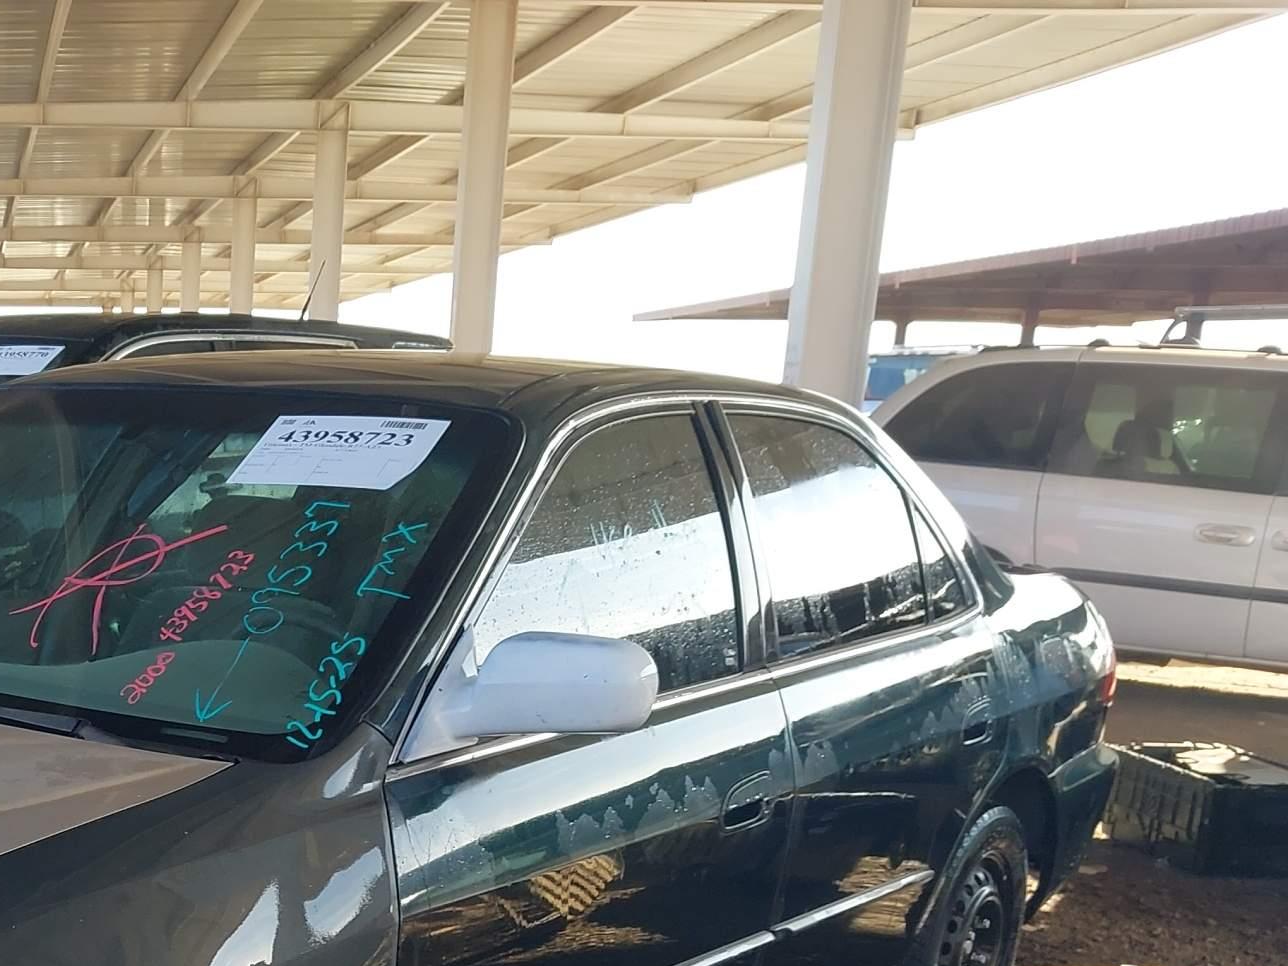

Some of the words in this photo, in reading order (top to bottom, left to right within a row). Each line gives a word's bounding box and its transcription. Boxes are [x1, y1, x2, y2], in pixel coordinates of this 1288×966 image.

[278, 429, 415, 447] 43958723
[120, 651, 175, 705] 2000
[159, 550, 255, 642] 43958723
